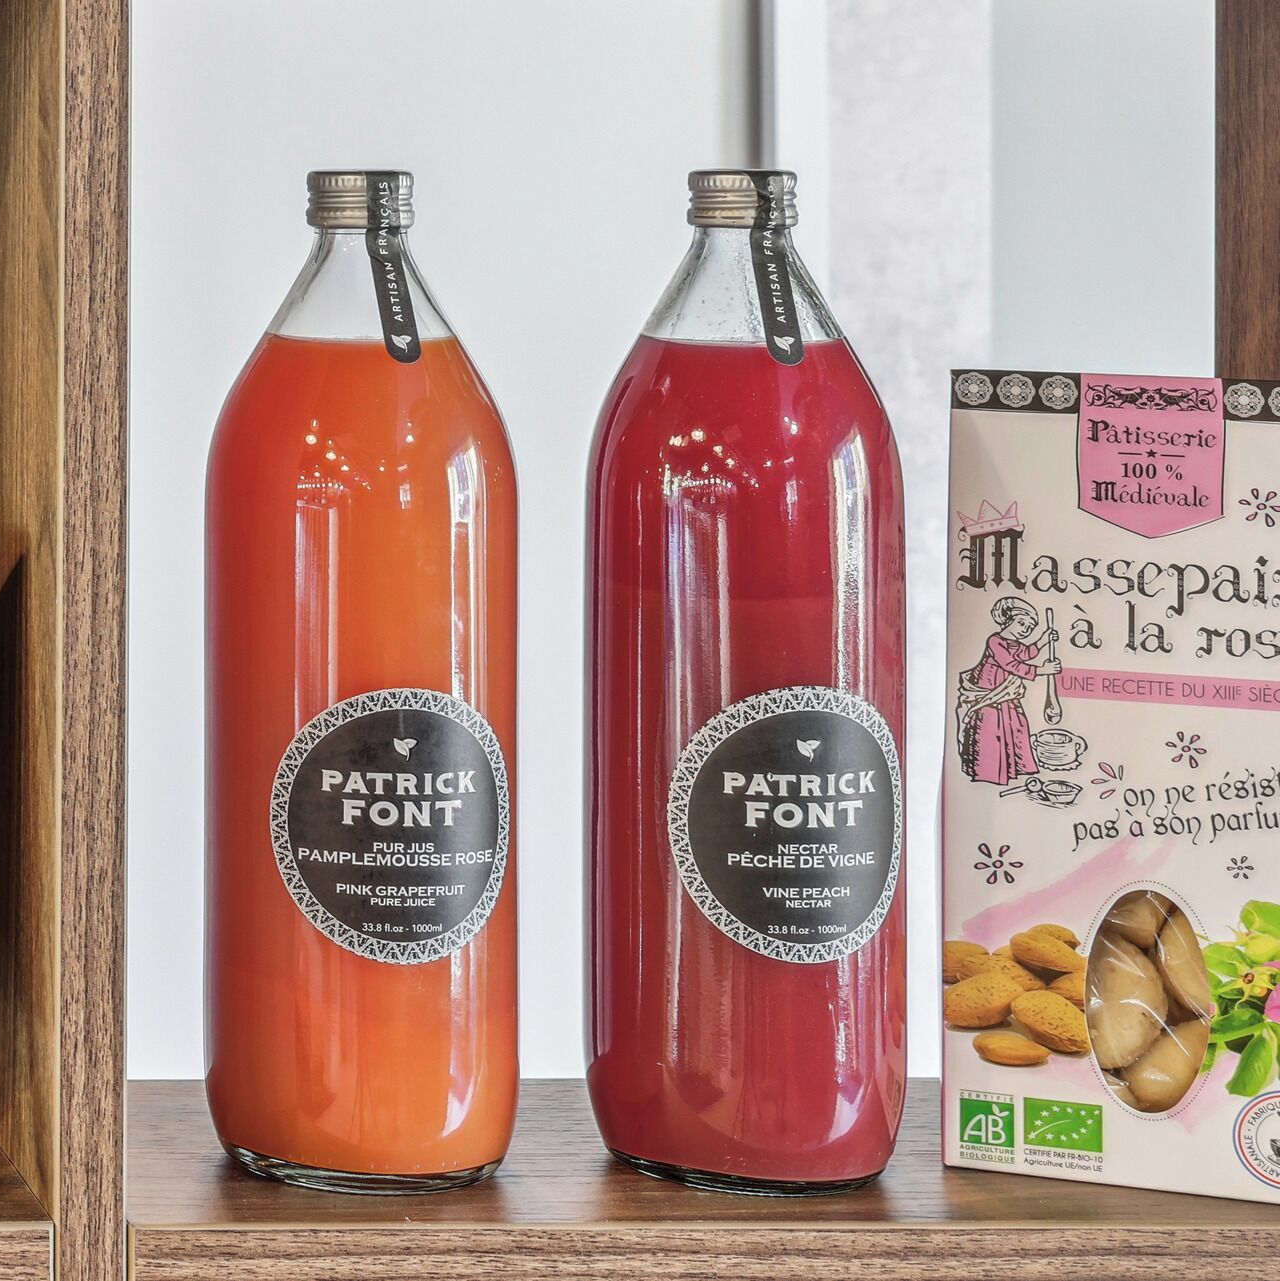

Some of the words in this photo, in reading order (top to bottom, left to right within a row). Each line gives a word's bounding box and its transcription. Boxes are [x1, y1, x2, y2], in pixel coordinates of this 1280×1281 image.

[386, 262, 403, 322] ARTISAN
[767, 263, 785, 323] ARTISAN
[1086, 418, 1217, 451] Pâtisserie
[1120, 462, 1157, 480] 100
[1091, 478, 1210, 509] Médiévale
[956, 522, 1280, 619] Massepai
[1069, 604, 1102, 651] à
[1125, 599, 1173, 656] la
[1061, 674, 1096, 694] UNE
[1101, 677, 1176, 698] RECETTE
[1182, 681, 1206, 699] DU
[321, 769, 477, 795] PATRICK
[723, 770, 876, 797] PATRICK
[1124, 784, 1156, 816] on
[1165, 783, 1199, 816] ne
[342, 799, 462, 827] FONT
[745, 800, 863, 828] FONT
[1072, 808, 1120, 851] pas
[1155, 808, 1201, 844] son
[298, 847, 452, 867] PAMPLEMOUSSE
[455, 849, 493, 865] ROSE
[373, 842, 405, 853] PUR
[408, 842, 434, 853] JUS
[727, 851, 795, 868] PÊCHE
[800, 856, 824, 868] DE
[828, 851, 875, 867] VIGNE
[778, 843, 838, 854] NECTAR
[336, 883, 372, 896] PINK
[376, 884, 465, 897] GRAPEFRUIT
[370, 897, 402, 907] PURE
[404, 897, 436, 907] JUICE
[762, 887, 799, 898] VINE
[803, 886, 850, 898] PEACH
[786, 899, 831, 908] NECTAR
[362, 922, 382, 932] 33.8
[412, 923, 442, 933] 1000ml
[963, 1113, 1006, 1144] AB
[960, 1144, 1015, 1155] AGRICULTURE
